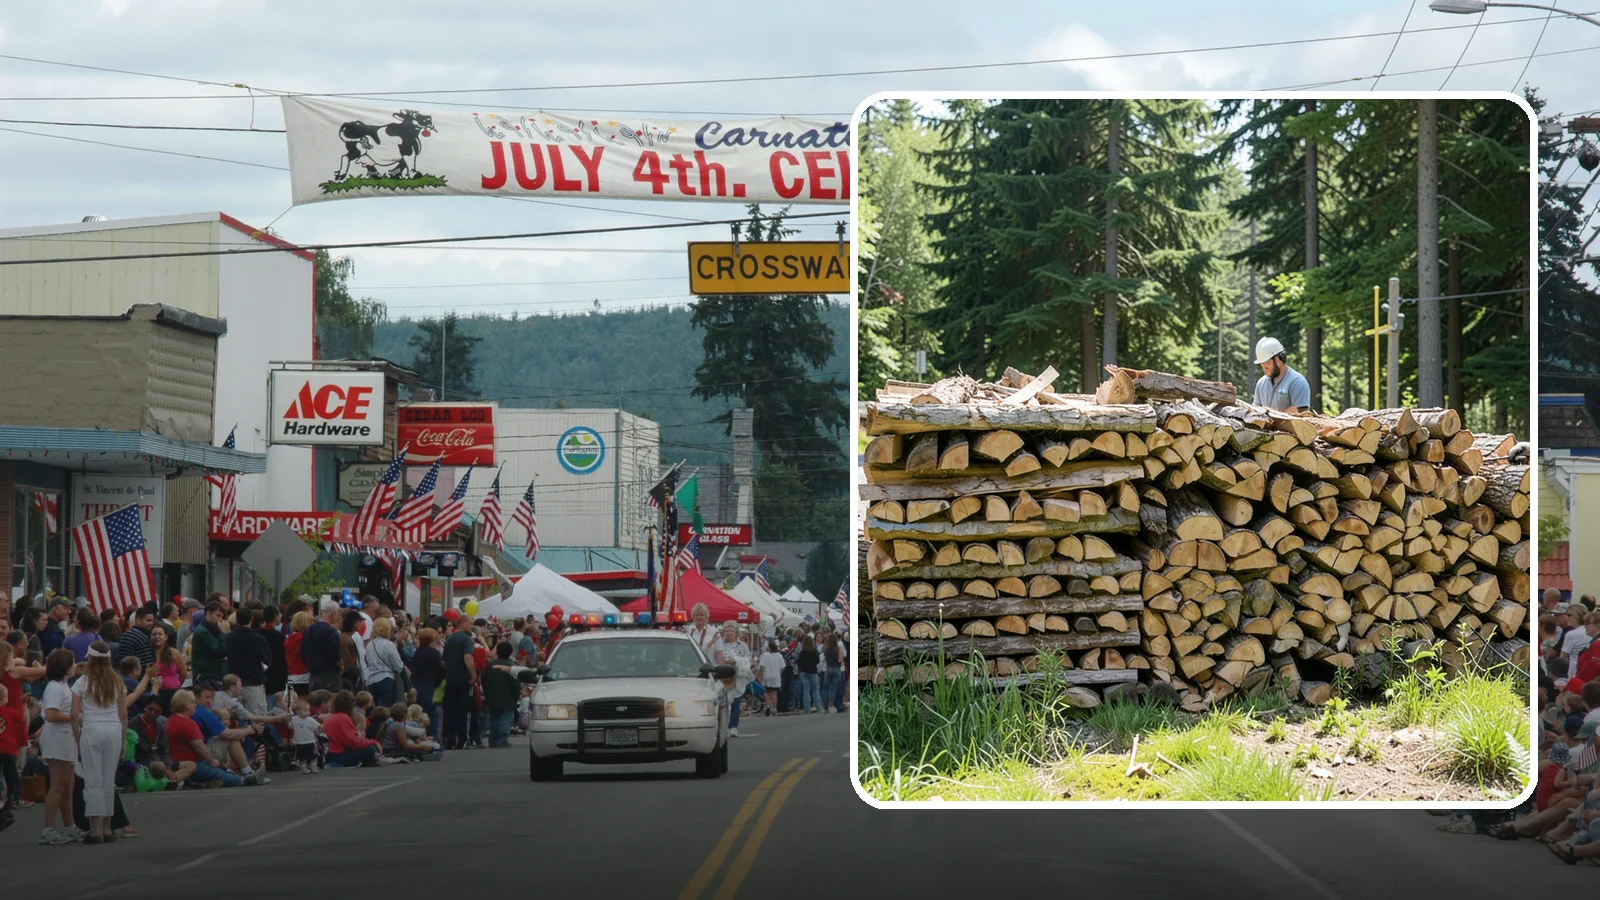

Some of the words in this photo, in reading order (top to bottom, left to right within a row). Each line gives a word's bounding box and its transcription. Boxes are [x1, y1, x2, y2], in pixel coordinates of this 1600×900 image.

[481, 141, 604, 192] JULY
[632, 149, 746, 198] 4th.
[697, 254, 850, 280] CROSSWA
[282, 380, 373, 420] ACE
[405, 409, 452, 422] CEDAR
[461, 409, 485, 422] LOG
[283, 421, 371, 436] Hardware
[416, 428, 477, 447] Coca-Cola
[95, 485, 124, 494] Vincent
[126, 486, 136, 494] de
[138, 486, 155, 495] Paul
[80, 503, 154, 522] THRT
[688, 527, 741, 535] CRNATION
[699, 535, 730, 543] GLASS
